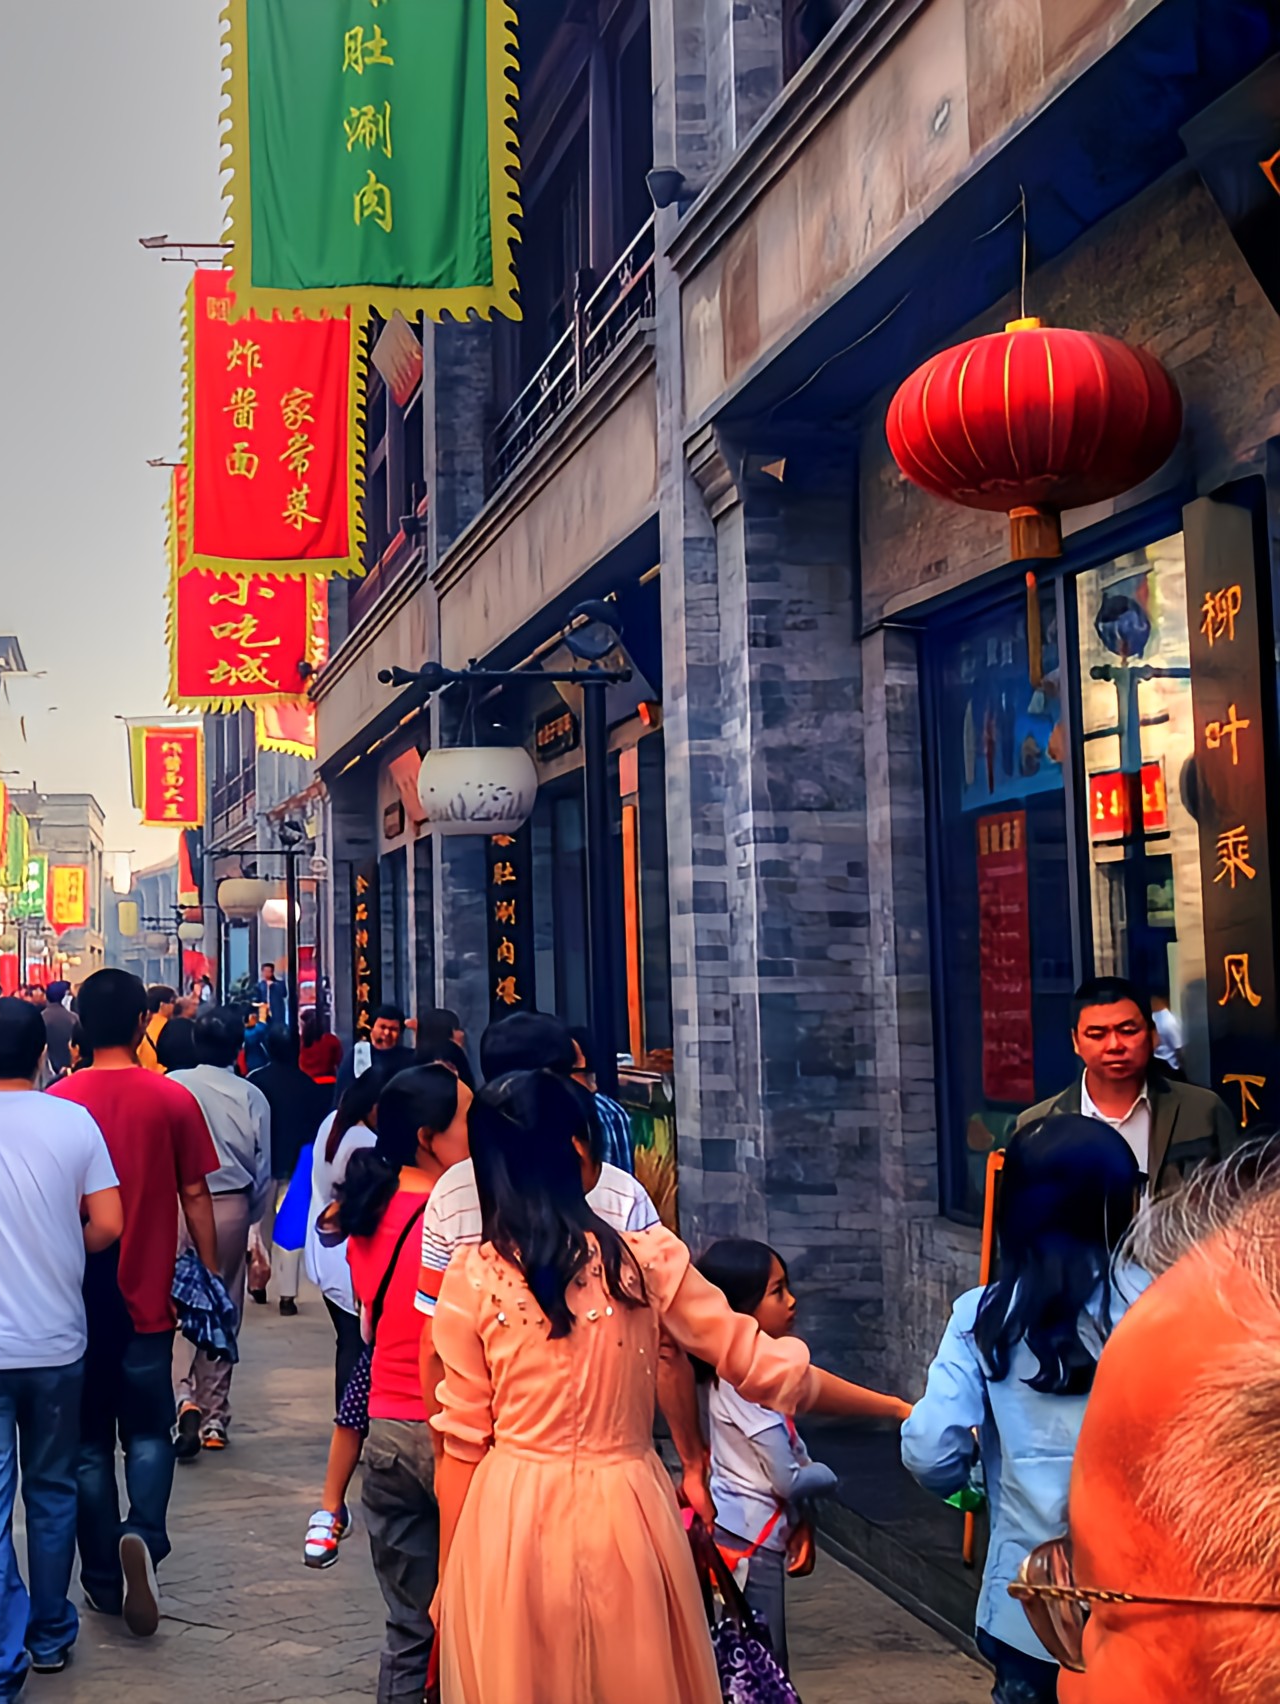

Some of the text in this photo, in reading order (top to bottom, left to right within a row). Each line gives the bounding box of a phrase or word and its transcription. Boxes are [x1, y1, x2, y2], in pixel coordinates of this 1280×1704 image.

[342, 0, 395, 233] 肚涮肉
[278, 387, 321, 531] 家常菜
